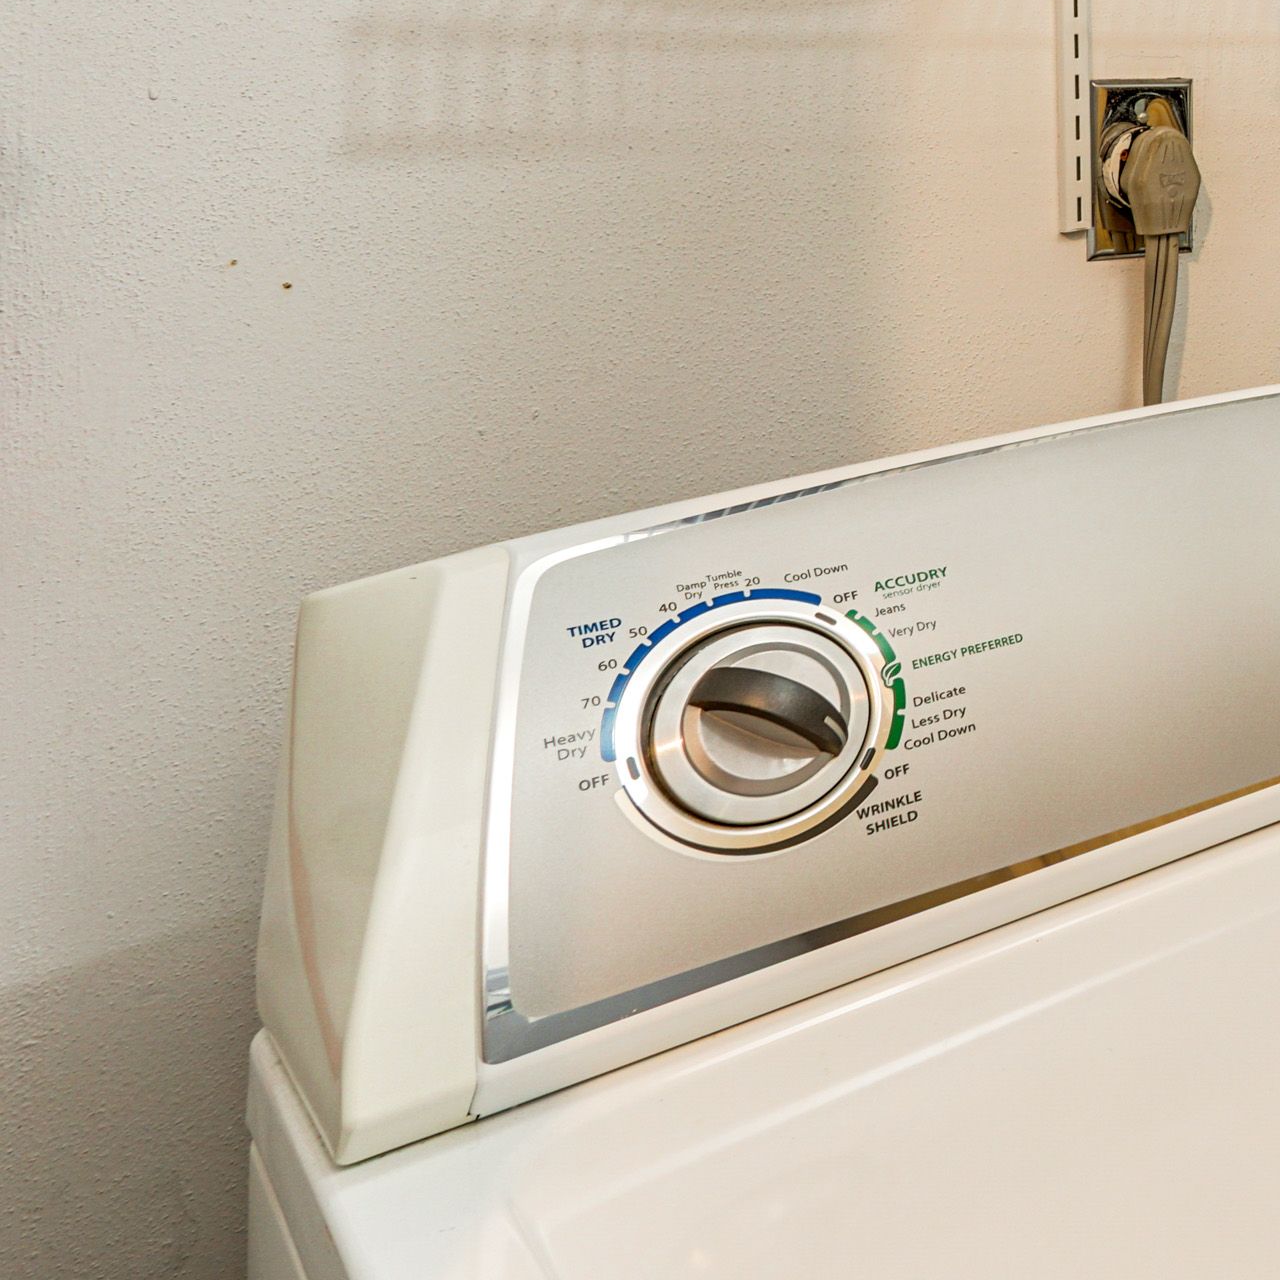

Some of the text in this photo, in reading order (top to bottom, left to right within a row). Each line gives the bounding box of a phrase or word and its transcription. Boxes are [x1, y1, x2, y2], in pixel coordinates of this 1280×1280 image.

[706, 569, 743, 583] Tumble
[783, 562, 848, 584] Cool Down
[874, 566, 948, 592] ACCUDRY
[676, 580, 707, 594] Damp
[713, 579, 740, 591] Press
[745, 576, 760, 588] 20
[882, 580, 941, 600] sensor dryer
[684, 590, 703, 601] Dry
[833, 590, 859, 605] OFF
[658, 601, 678, 614] 40
[875, 602, 906, 618] Jeans
[566, 617, 623, 638] TIMED
[629, 626, 648, 639] 50
[888, 618, 938, 639] Very Dry
[582, 632, 616, 649] DRY
[911, 632, 1023, 670] ENERGY PREFERRED
[598, 658, 618, 672] 60
[581, 695, 601, 710] 70
[913, 685, 967, 707] Delicate
[911, 707, 967, 729] Less Dry
[543, 727, 596, 749] Heavy
[904, 723, 977, 751] Cool Down
[557, 745, 588, 761] Dry
[884, 763, 911, 780] OFF
[578, 773, 611, 792] OFF
[856, 790, 923, 820] WRINKLE
[865, 810, 919, 836] SHIELD
